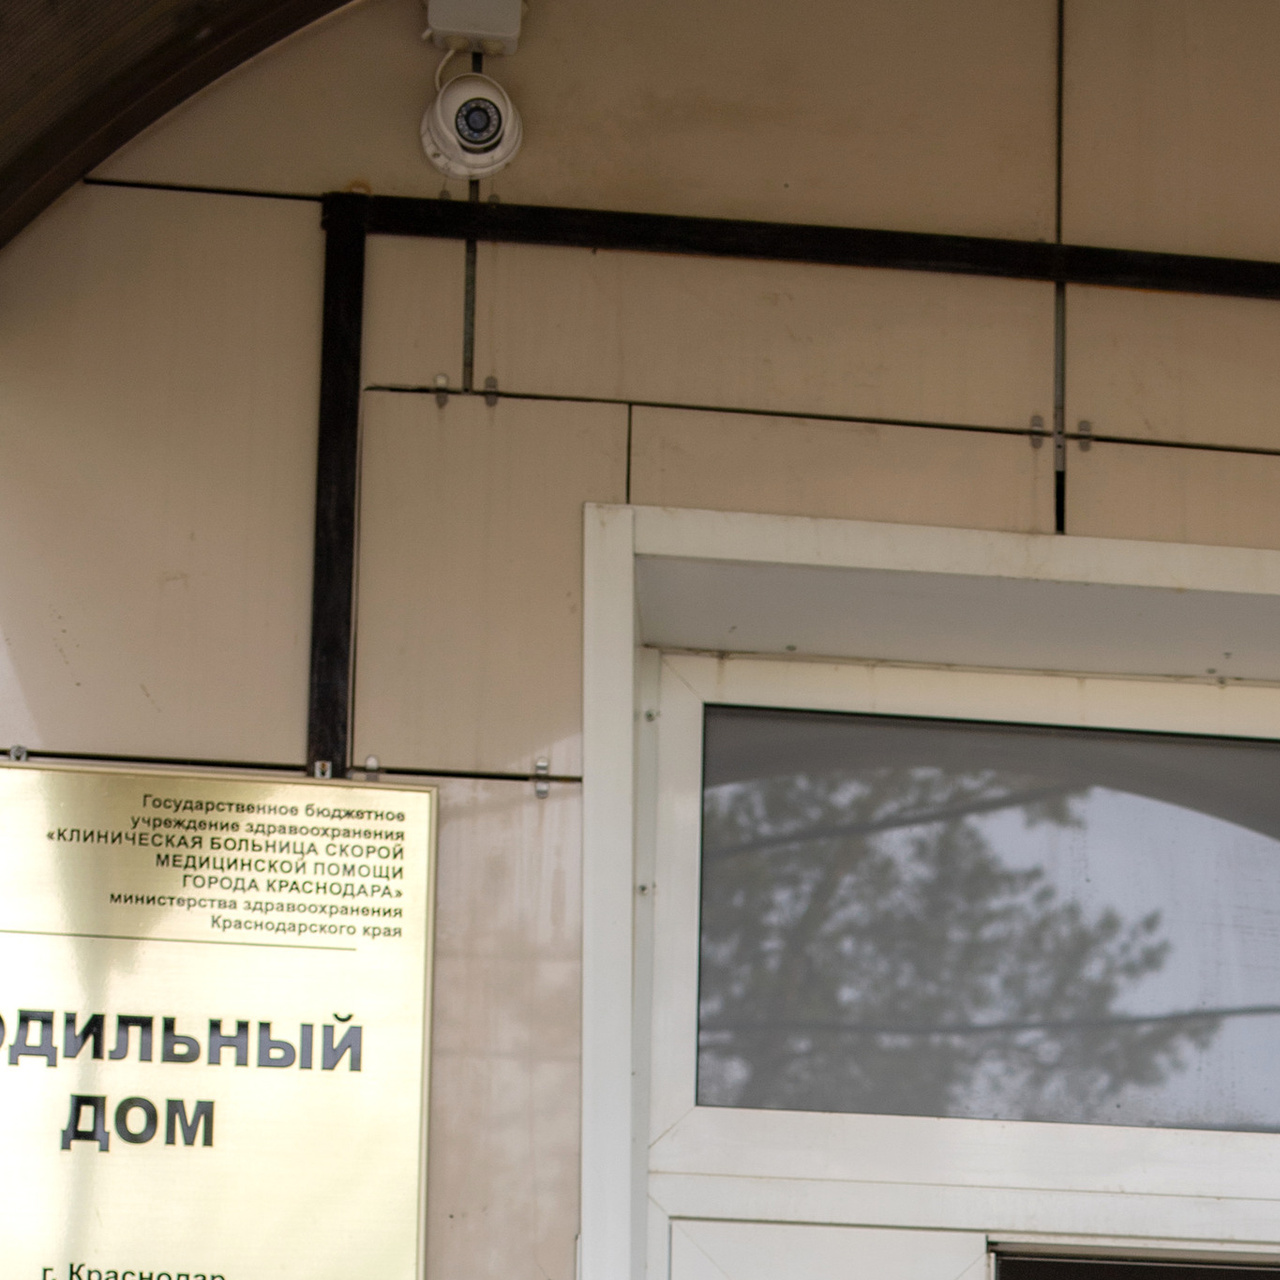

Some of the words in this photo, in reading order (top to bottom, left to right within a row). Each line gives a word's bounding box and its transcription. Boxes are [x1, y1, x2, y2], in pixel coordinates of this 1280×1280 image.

[142, 793, 299, 816] Государственное
[305, 803, 406, 822] бюджетное
[131, 816, 240, 832] учреждение
[245, 821, 405, 841] здравоохранения
[47, 828, 203, 850] «КЛИНИЧЕСКАЯ
[210, 837, 318, 857] БОЛЬНИЦА
[325, 843, 404, 860] СКОРОЙ
[155, 853, 307, 875] МЕДИЦИНСКОЙ
[313, 862, 404, 880] ПОМОЩИ
[182, 874, 260, 892] ГОРОДА
[266, 879, 403, 898] КРАСНОДАРА»
[109, 893, 238, 910] министерства
[243, 900, 403, 919] здравоохранения
[211, 915, 356, 936] Краснодарского
[363, 926, 403, 940] края
[0, 1009, 363, 1072] ДИЛЬНЫЙ
[60, 1094, 215, 1152] ДОМ
